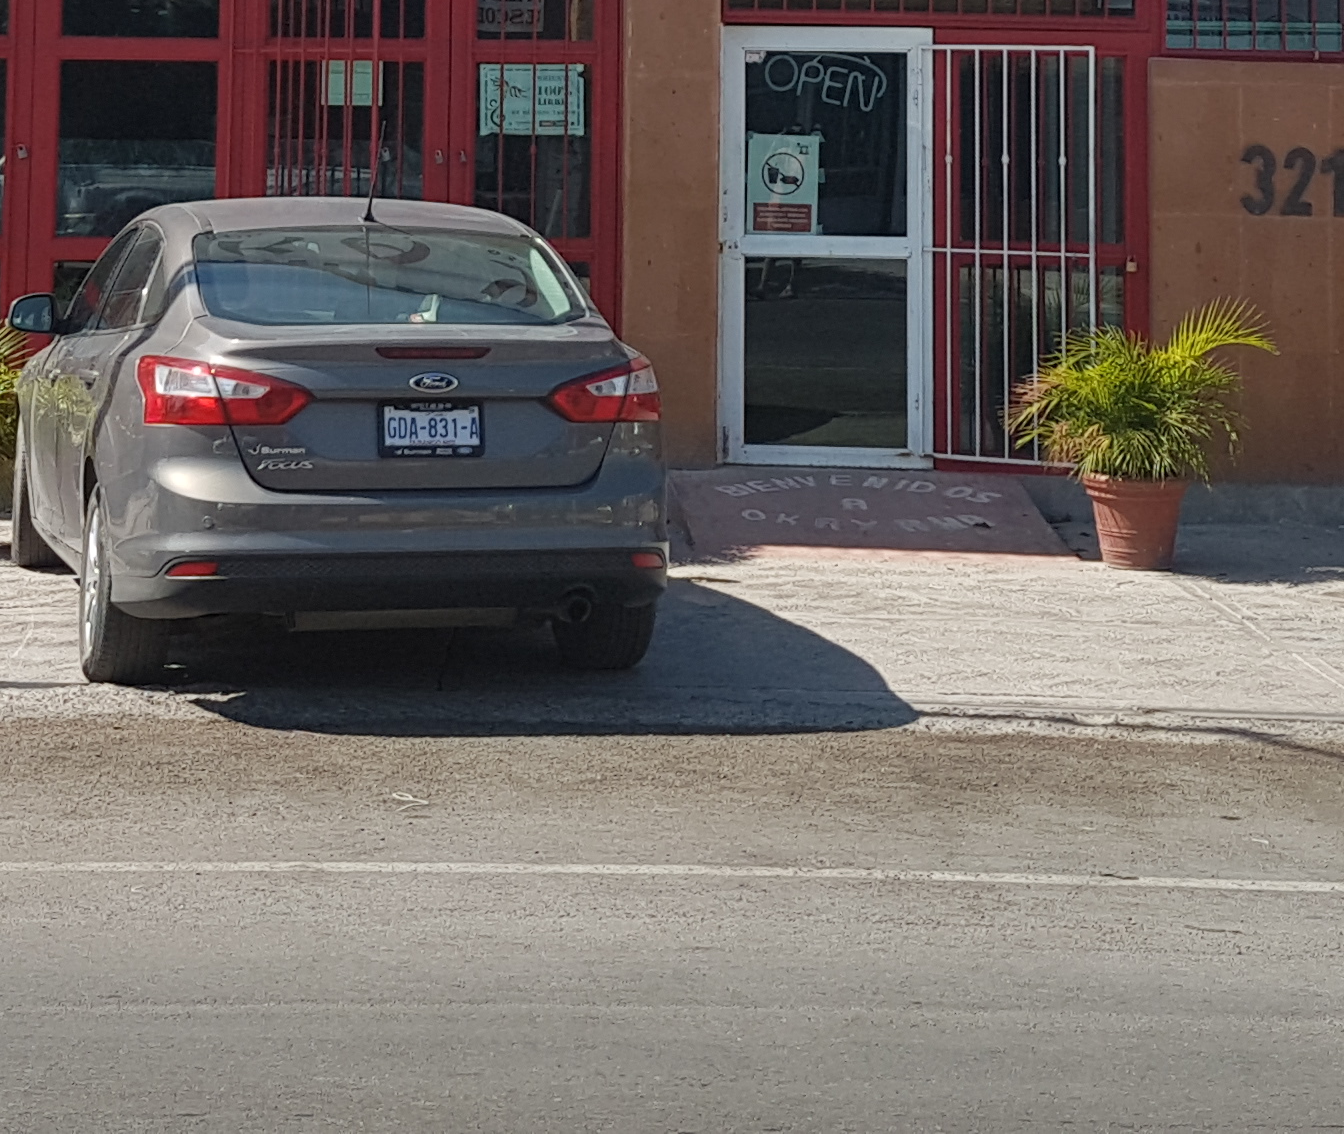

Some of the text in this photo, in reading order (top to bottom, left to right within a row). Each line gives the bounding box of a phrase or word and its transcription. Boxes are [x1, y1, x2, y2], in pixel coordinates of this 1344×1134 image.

[764, 54, 882, 112] OPEN
[387, 416, 479, 440] GDA-831-A
[713, 473, 1003, 504] BIENVENIDOS
